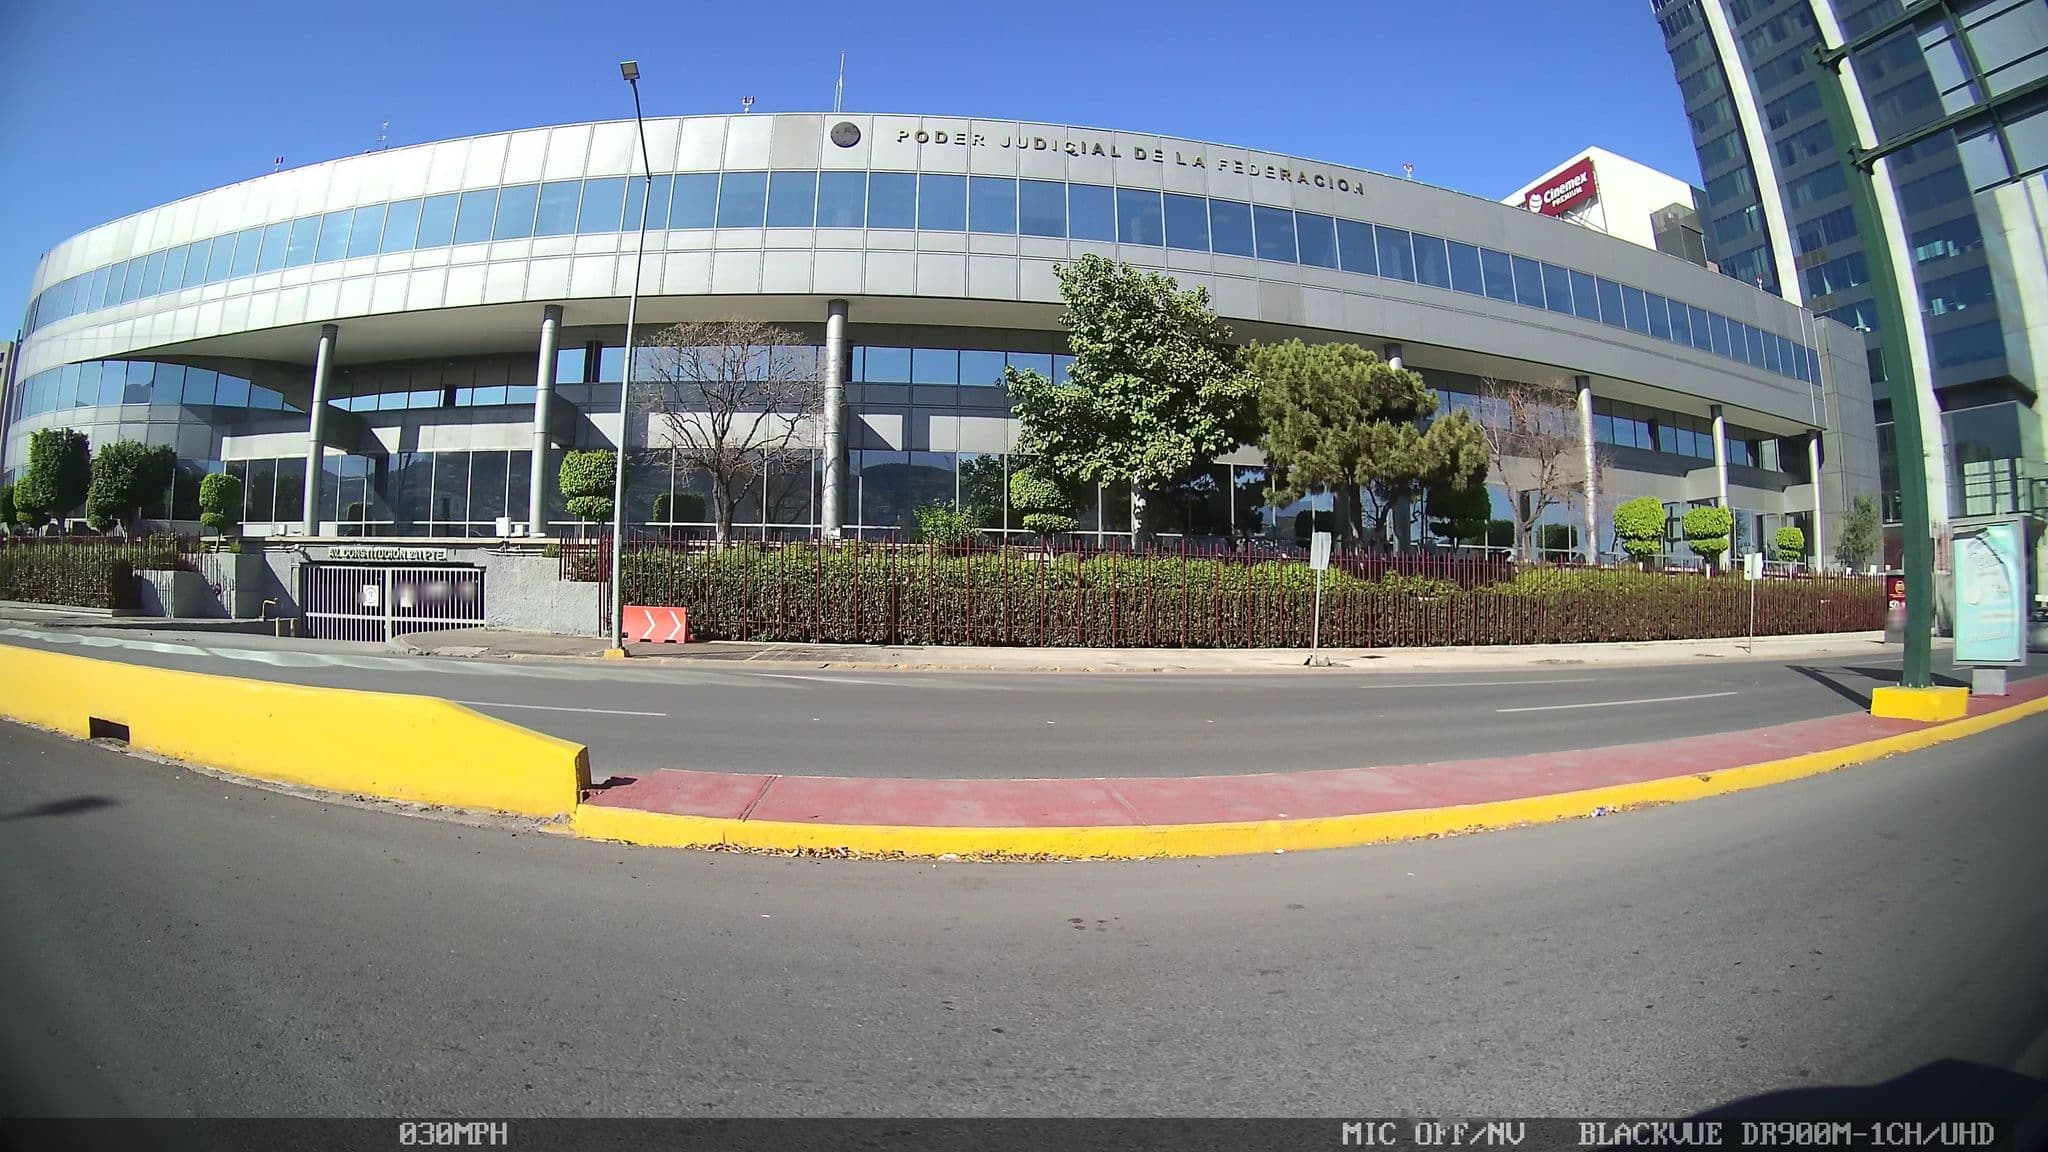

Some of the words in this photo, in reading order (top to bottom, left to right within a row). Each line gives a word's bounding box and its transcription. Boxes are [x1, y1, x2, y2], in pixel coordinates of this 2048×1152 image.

[896, 129, 985, 147] PODER
[999, 136, 1122, 157] JUDICIAL
[1133, 146, 1164, 163] DE
[1175, 151, 1206, 169] LA
[1543, 171, 1588, 204] Cinemex
[1552, 186, 1583, 207] PREMIUM
